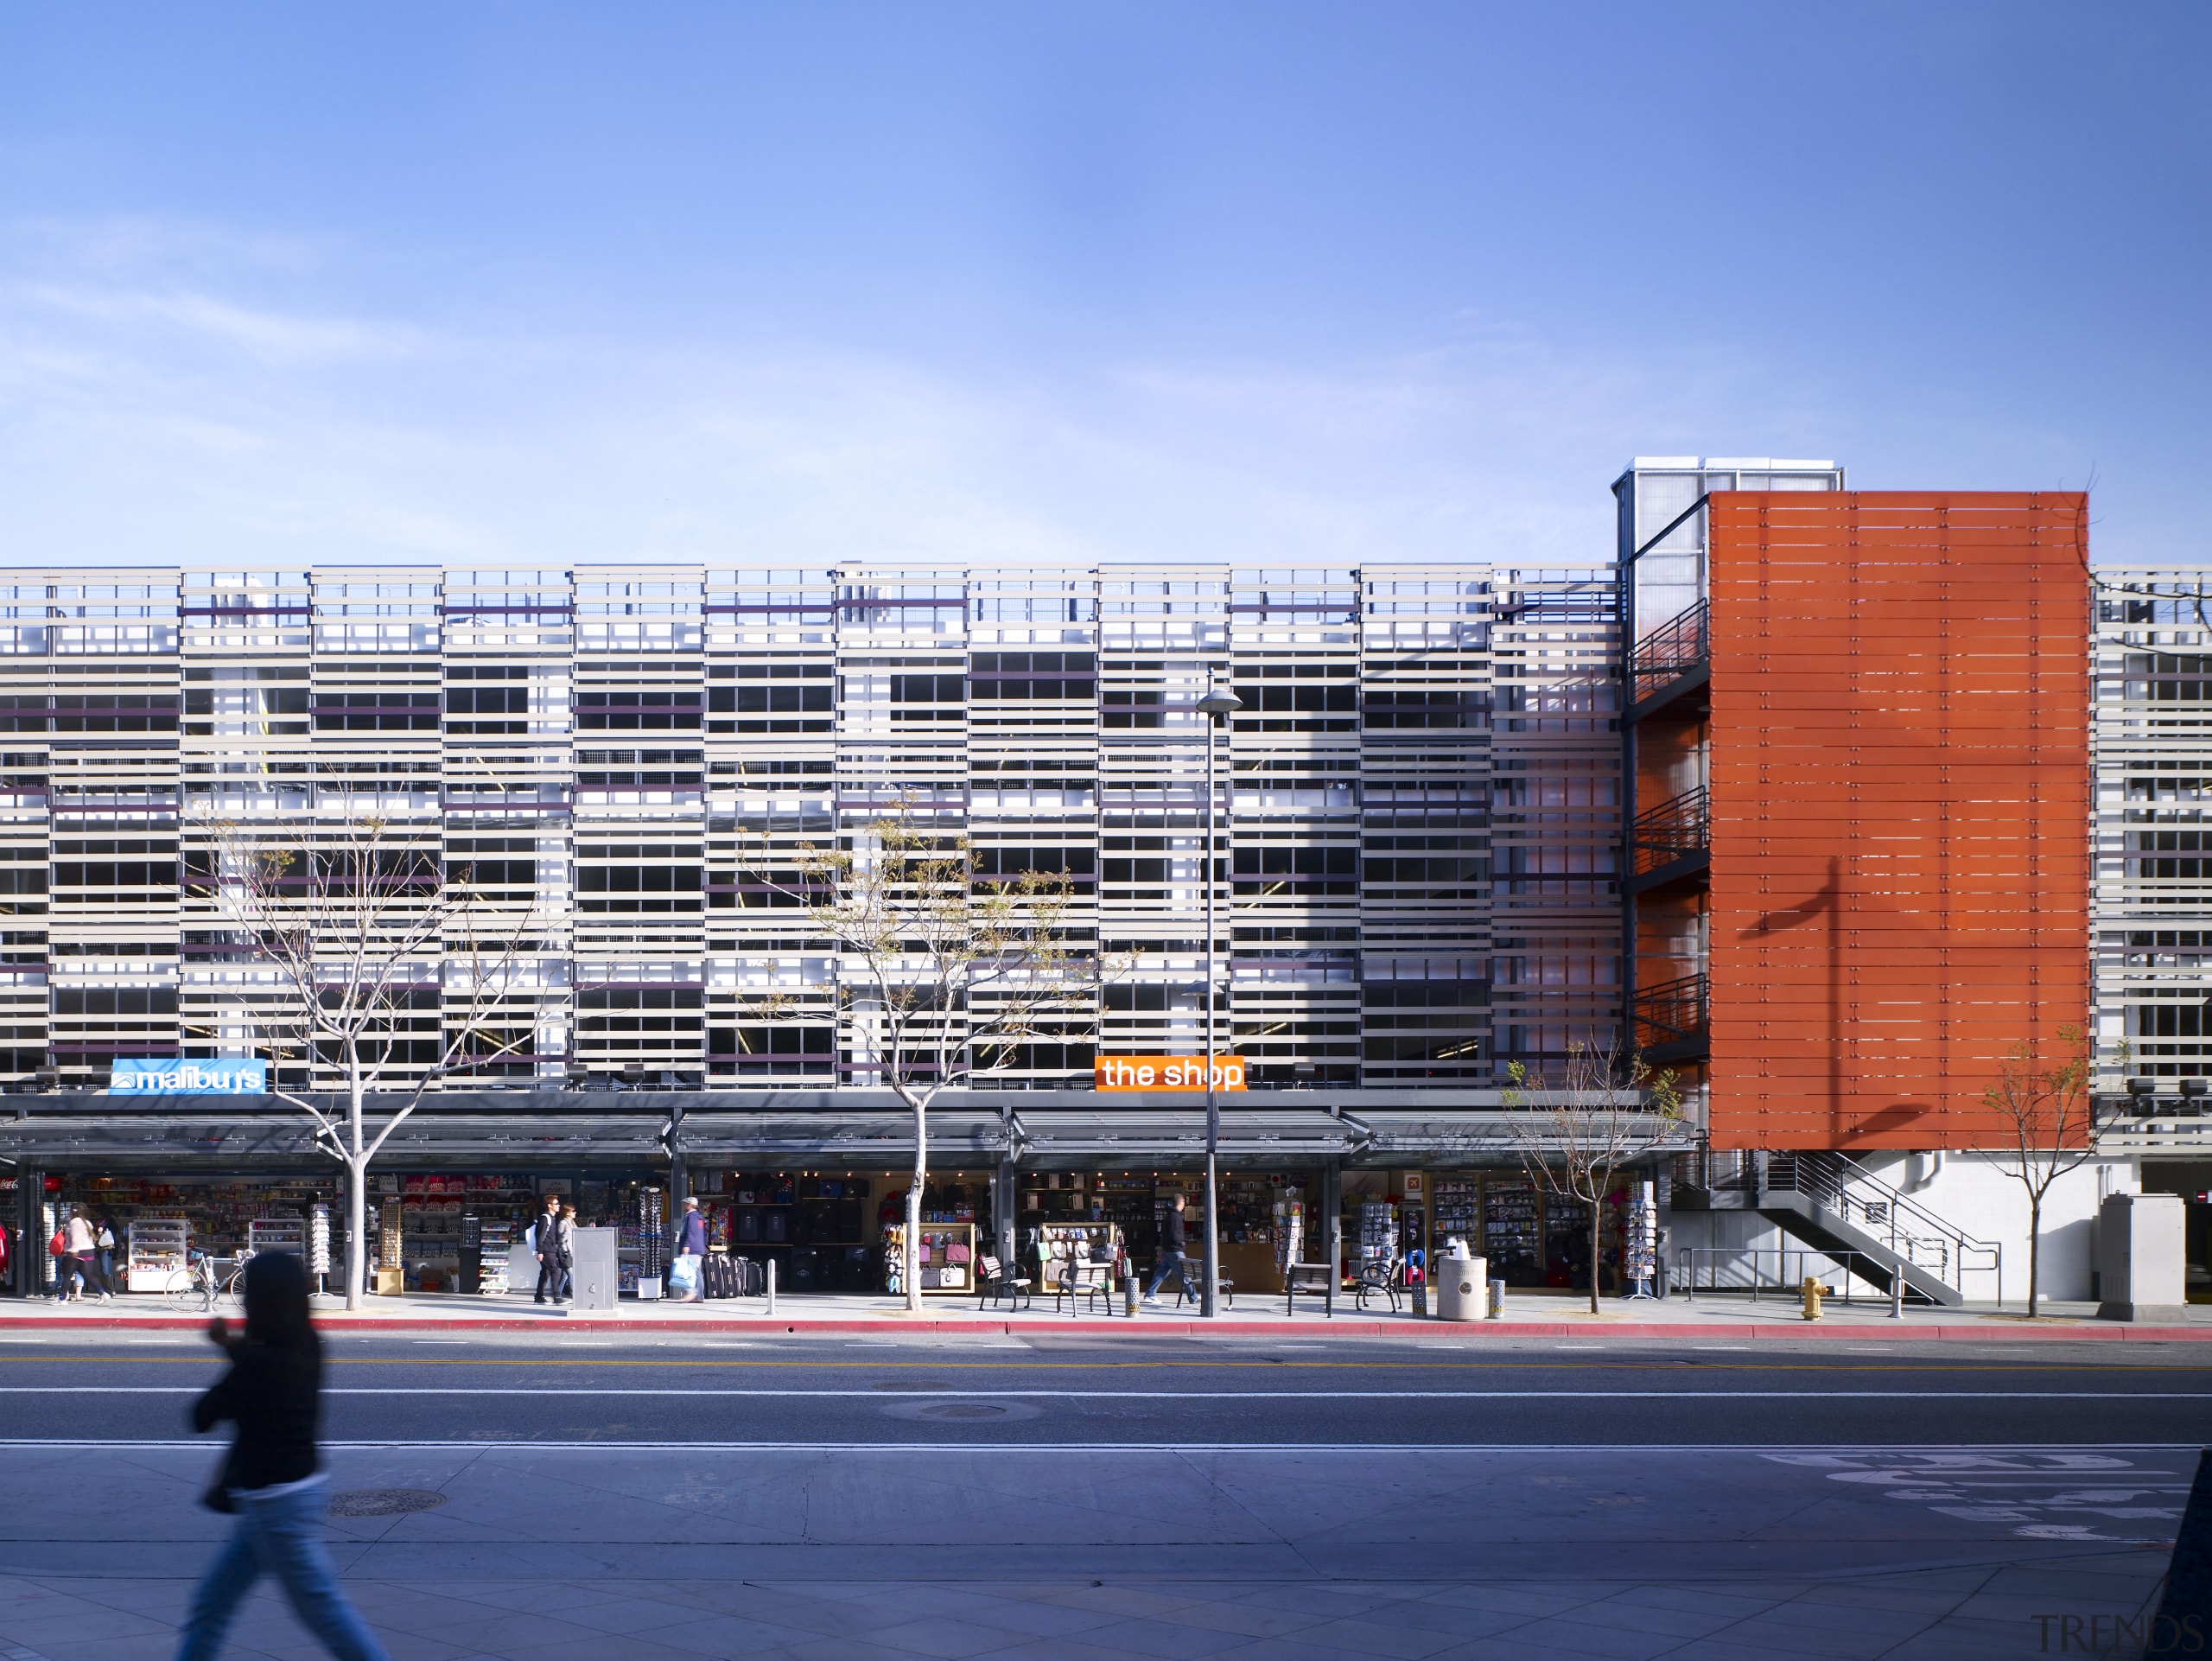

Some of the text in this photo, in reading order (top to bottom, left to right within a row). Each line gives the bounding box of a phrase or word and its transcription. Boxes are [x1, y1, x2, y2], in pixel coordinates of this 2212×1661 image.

[136, 1066, 262, 1094] malibu j's
[1102, 1060, 1243, 1091] the shop
[545, 1185, 565, 1193] evian
